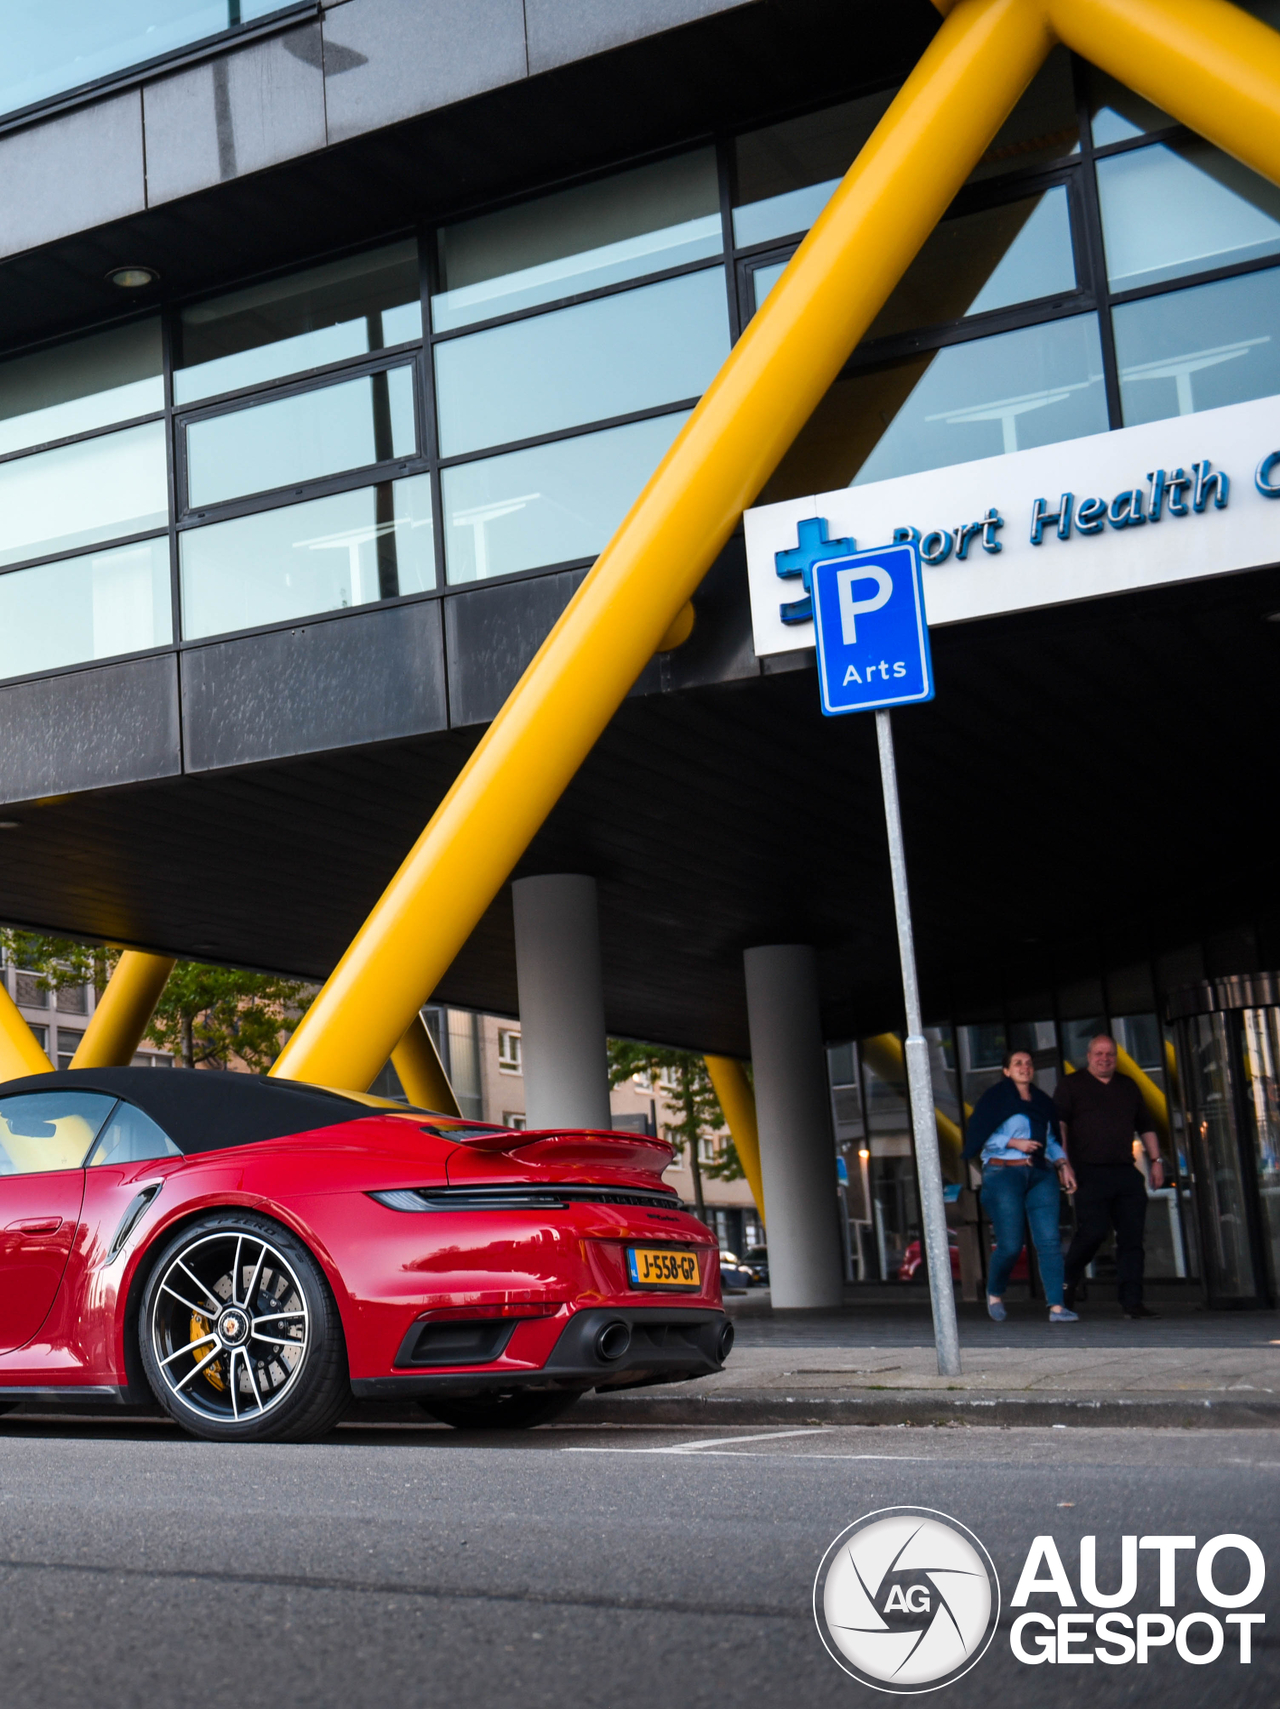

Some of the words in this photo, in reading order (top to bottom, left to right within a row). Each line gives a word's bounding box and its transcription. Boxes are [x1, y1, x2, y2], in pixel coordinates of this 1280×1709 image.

[1030, 459, 1231, 546] Health
[836, 564, 894, 646] P
[842, 659, 907, 687] Arts
[231, 1219, 277, 1236] ZERO
[643, 1254, 695, 1281] J-558-GP
